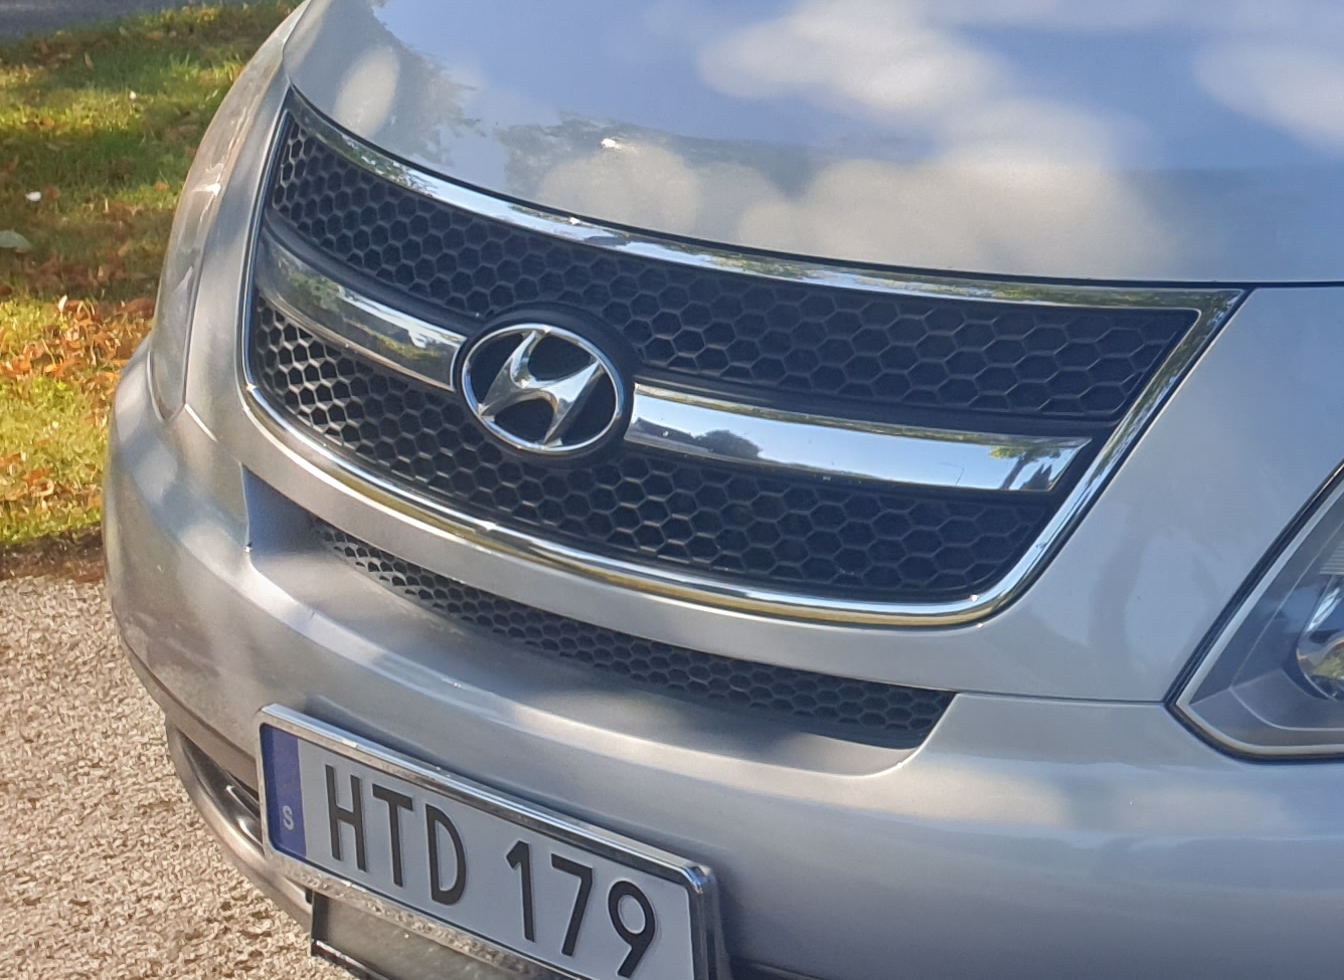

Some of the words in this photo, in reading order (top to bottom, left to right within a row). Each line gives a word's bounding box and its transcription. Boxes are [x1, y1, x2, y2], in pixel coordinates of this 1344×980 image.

[282, 805, 295, 831] S
[325, 764, 467, 906] HTD
[505, 840, 657, 979] 179
